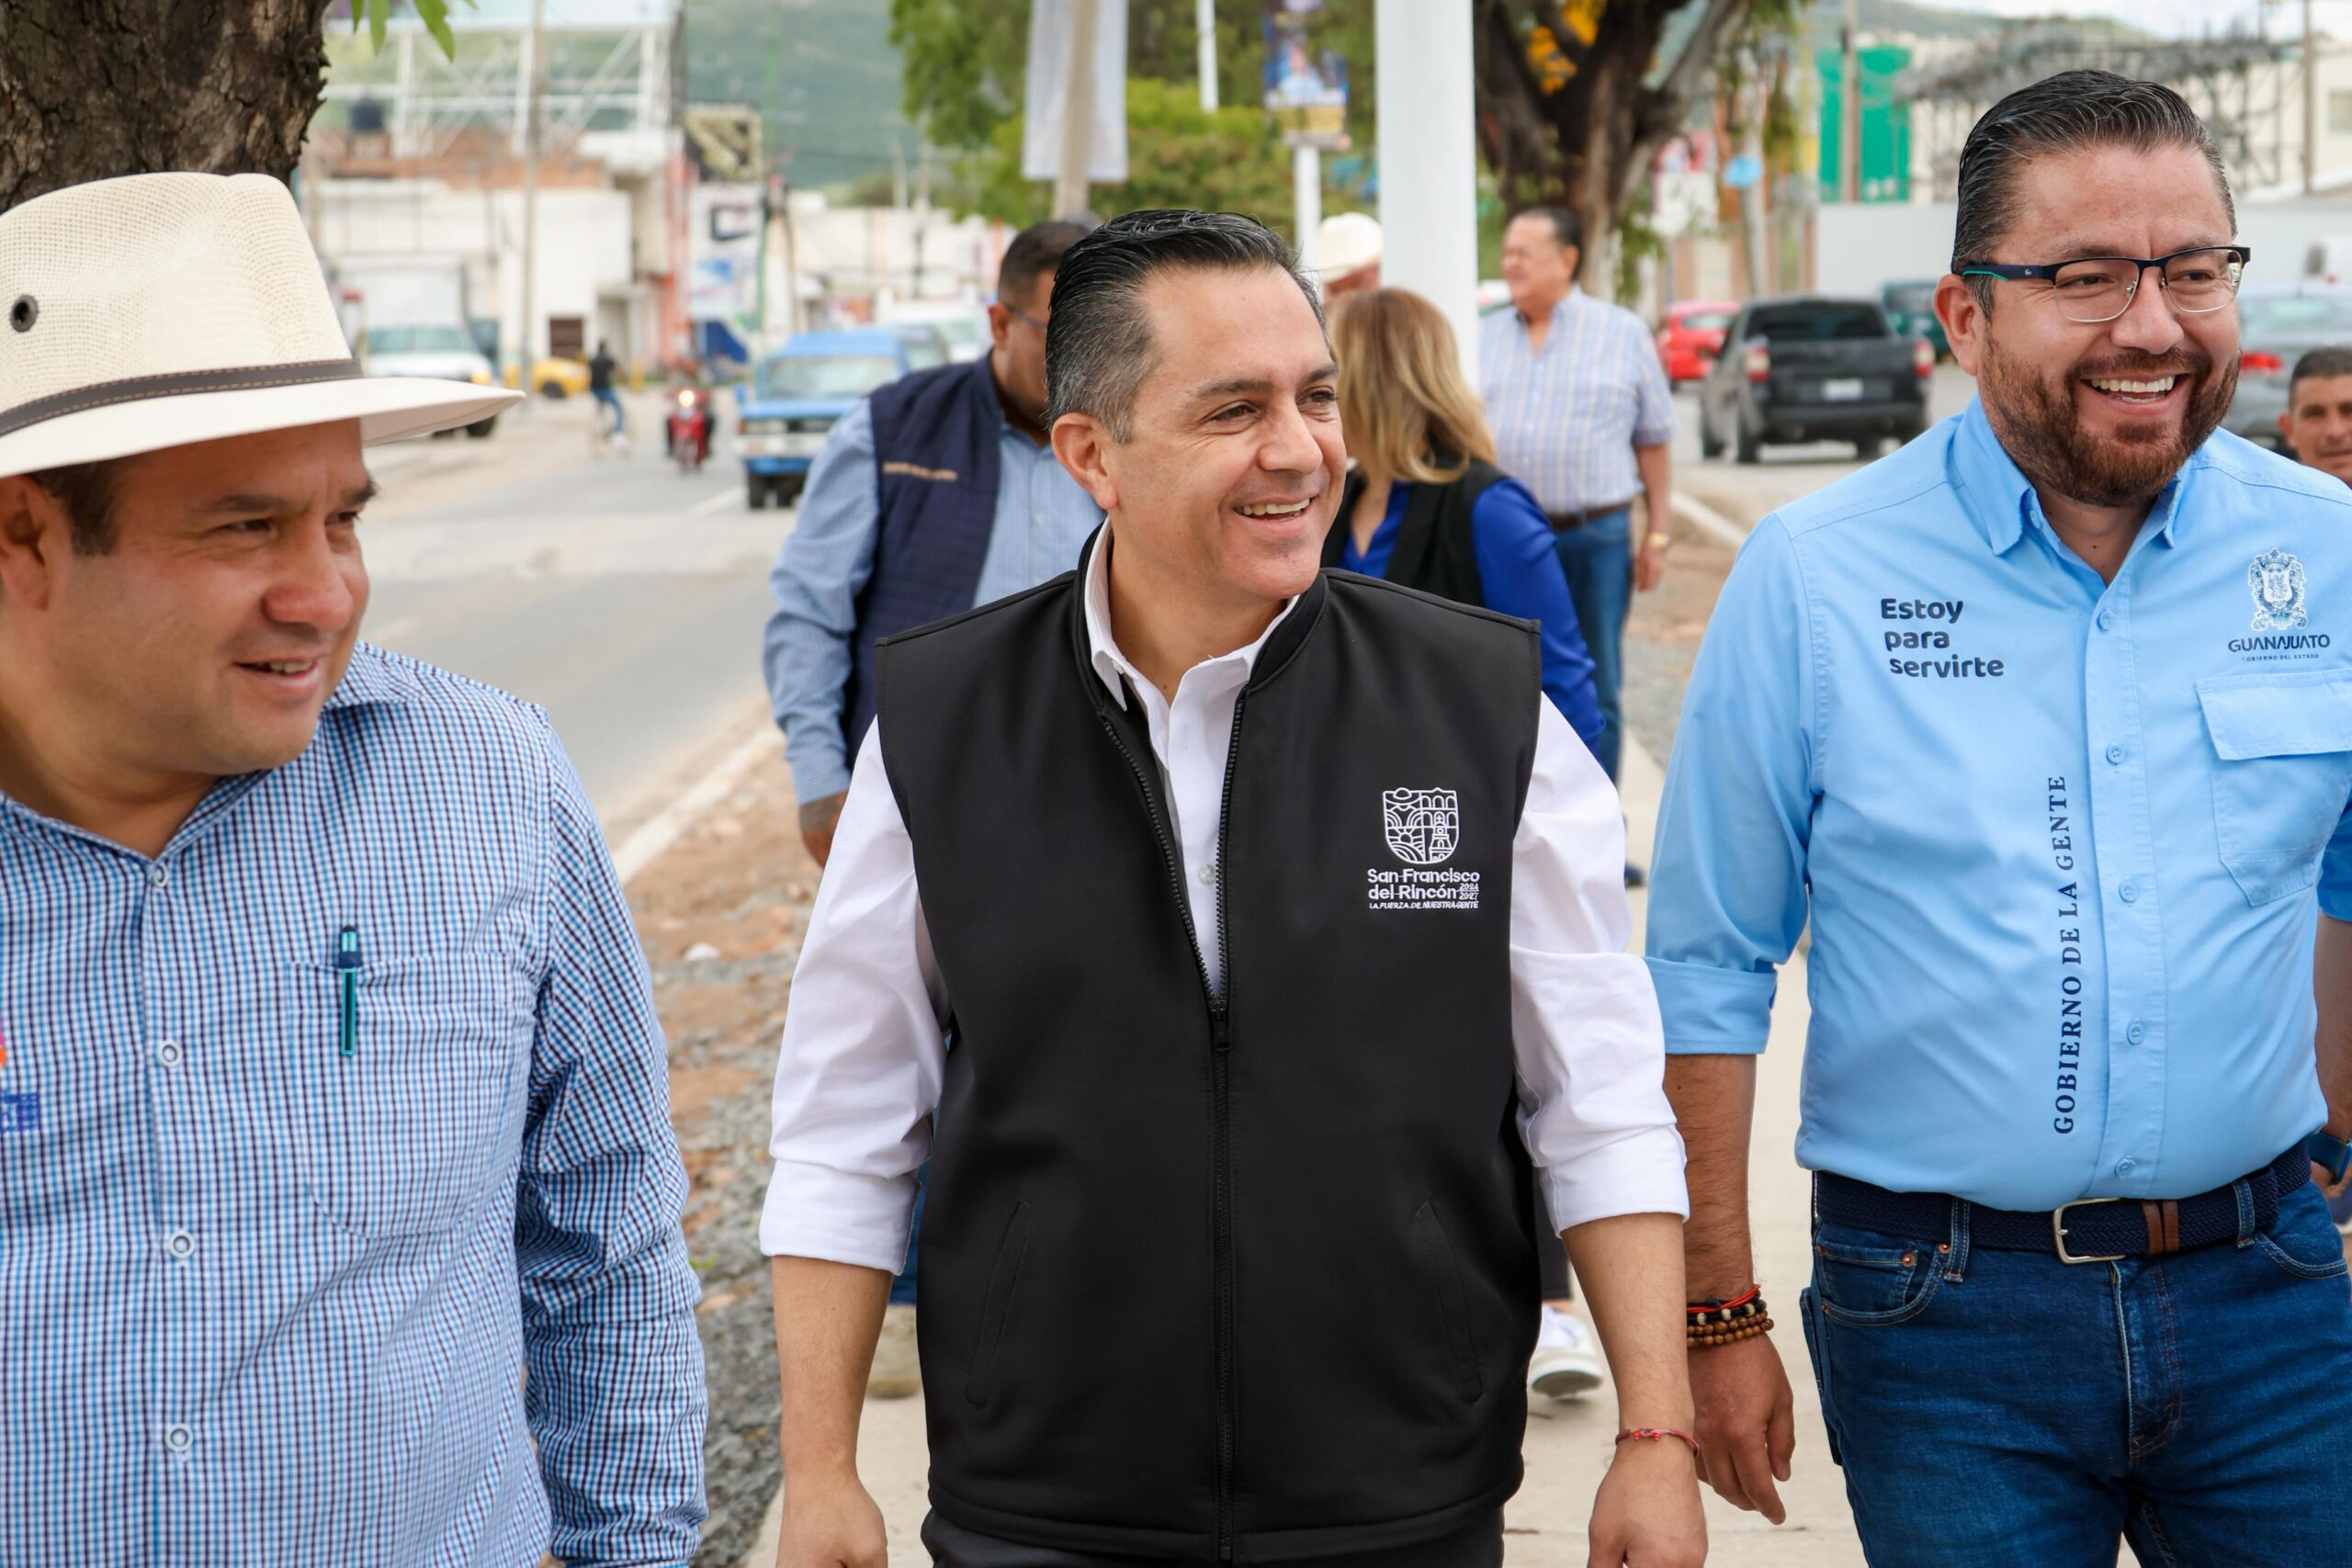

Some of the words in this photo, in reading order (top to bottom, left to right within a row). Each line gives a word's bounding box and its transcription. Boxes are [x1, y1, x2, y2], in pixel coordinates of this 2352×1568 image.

[1881, 598, 1963, 624] Estoy
[1884, 631, 1950, 651] para
[2228, 634, 2331, 652] GUANAJUATO
[1889, 653, 2004, 678] servirte
[2048, 776, 2075, 871] GENTE
[1367, 868, 1398, 883] San
[1403, 867, 1480, 883] Francisco
[1368, 884, 1394, 899] del
[1398, 884, 1456, 899] Rincón
[2057, 882, 2078, 918] LA
[1380, 901, 1409, 909] FUERZA
[1422, 900, 1456, 909] NUESTRA
[2060, 928, 2082, 965] DE
[2053, 976, 2082, 1134] GOBIERNO
